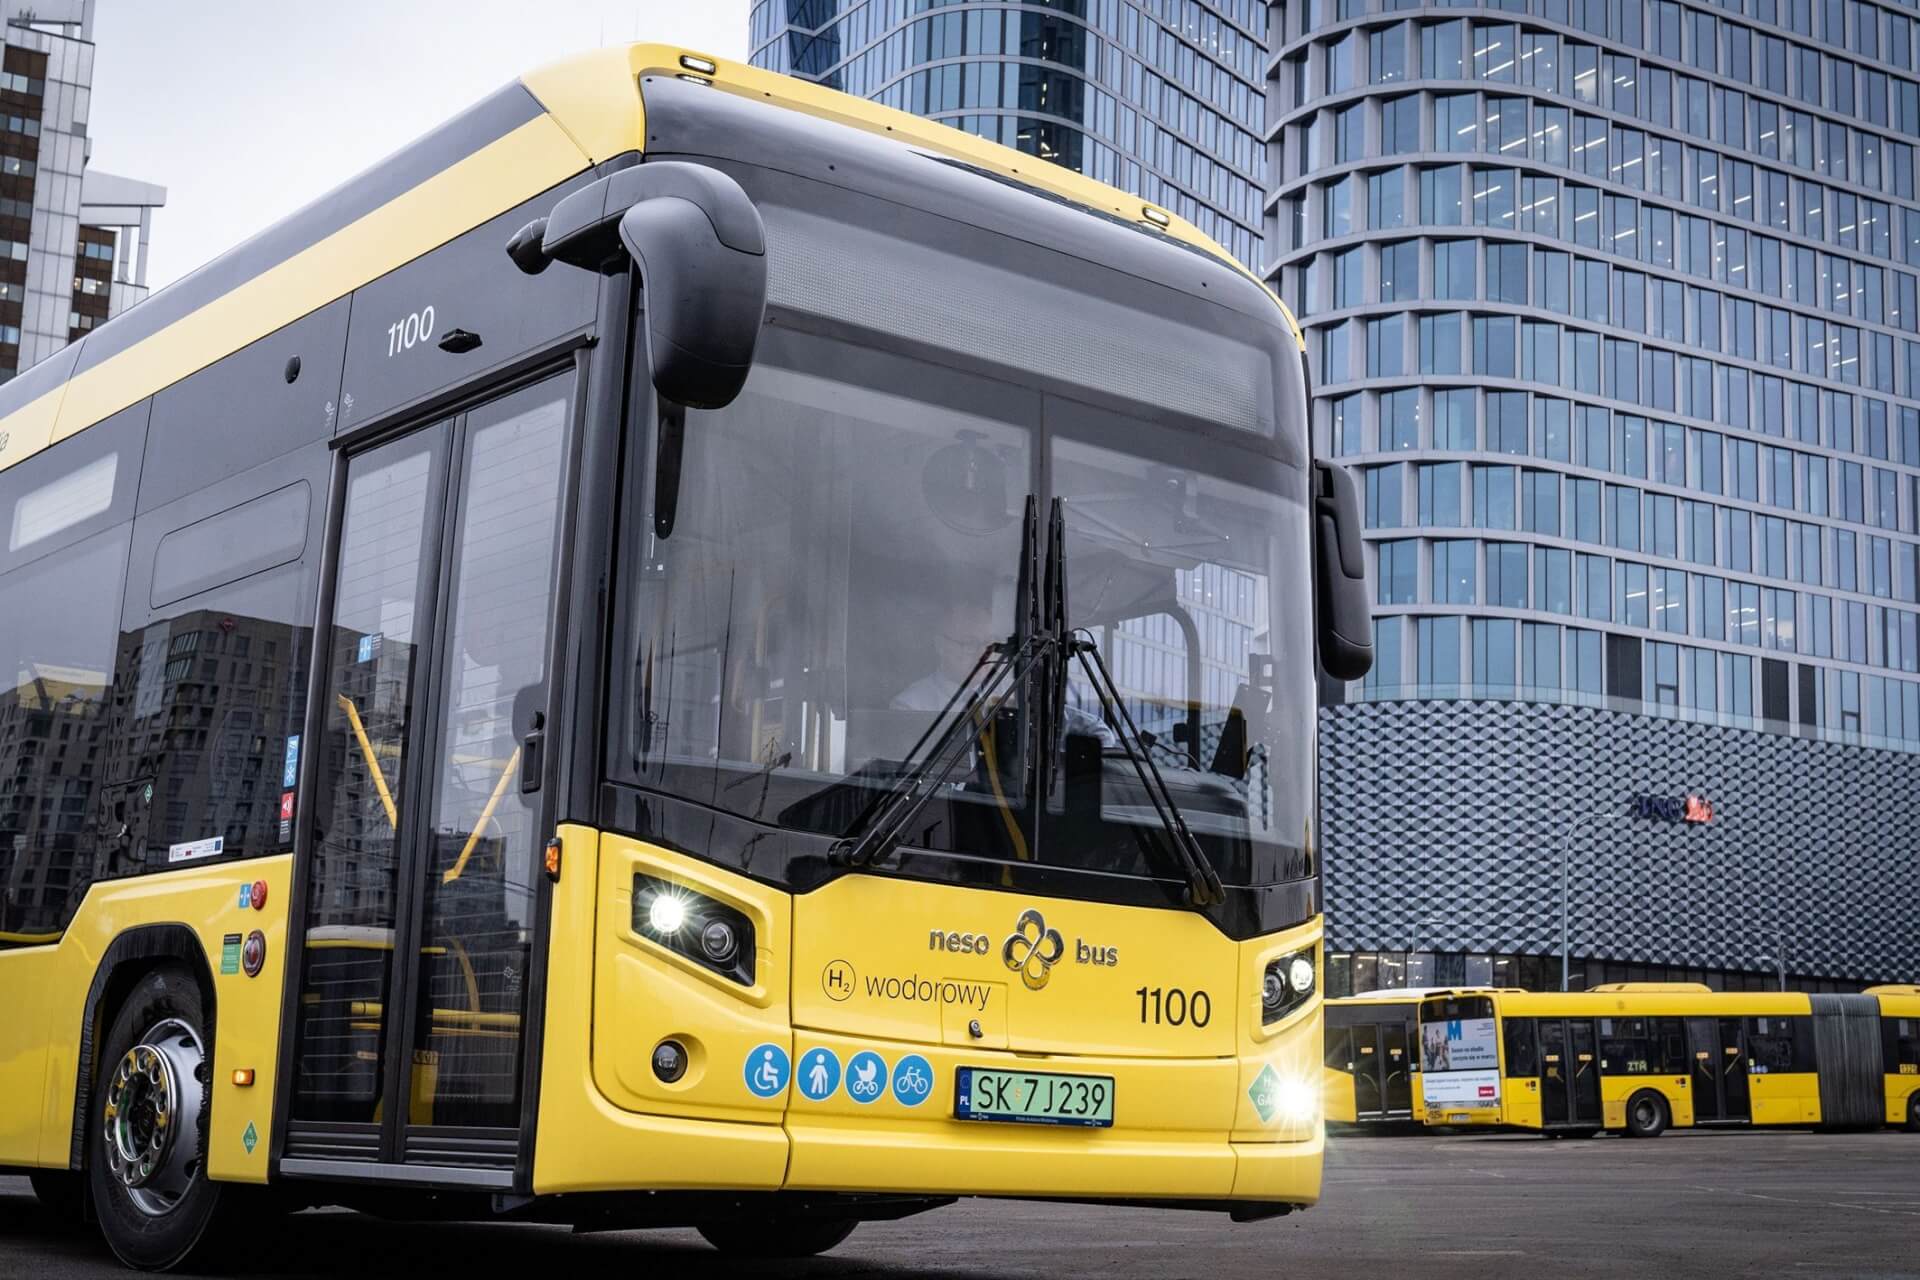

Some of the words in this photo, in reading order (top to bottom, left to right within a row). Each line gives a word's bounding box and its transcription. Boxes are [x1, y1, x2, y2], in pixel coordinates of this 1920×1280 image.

[388, 305, 435, 357] 1100
[929, 928, 990, 956] neso
[1076, 938, 1118, 967] bus
[866, 973, 991, 1011] wodorowy
[1136, 986, 1212, 1028] 1100
[960, 1096, 970, 1106] PL
[978, 1075, 1012, 1111] SK
